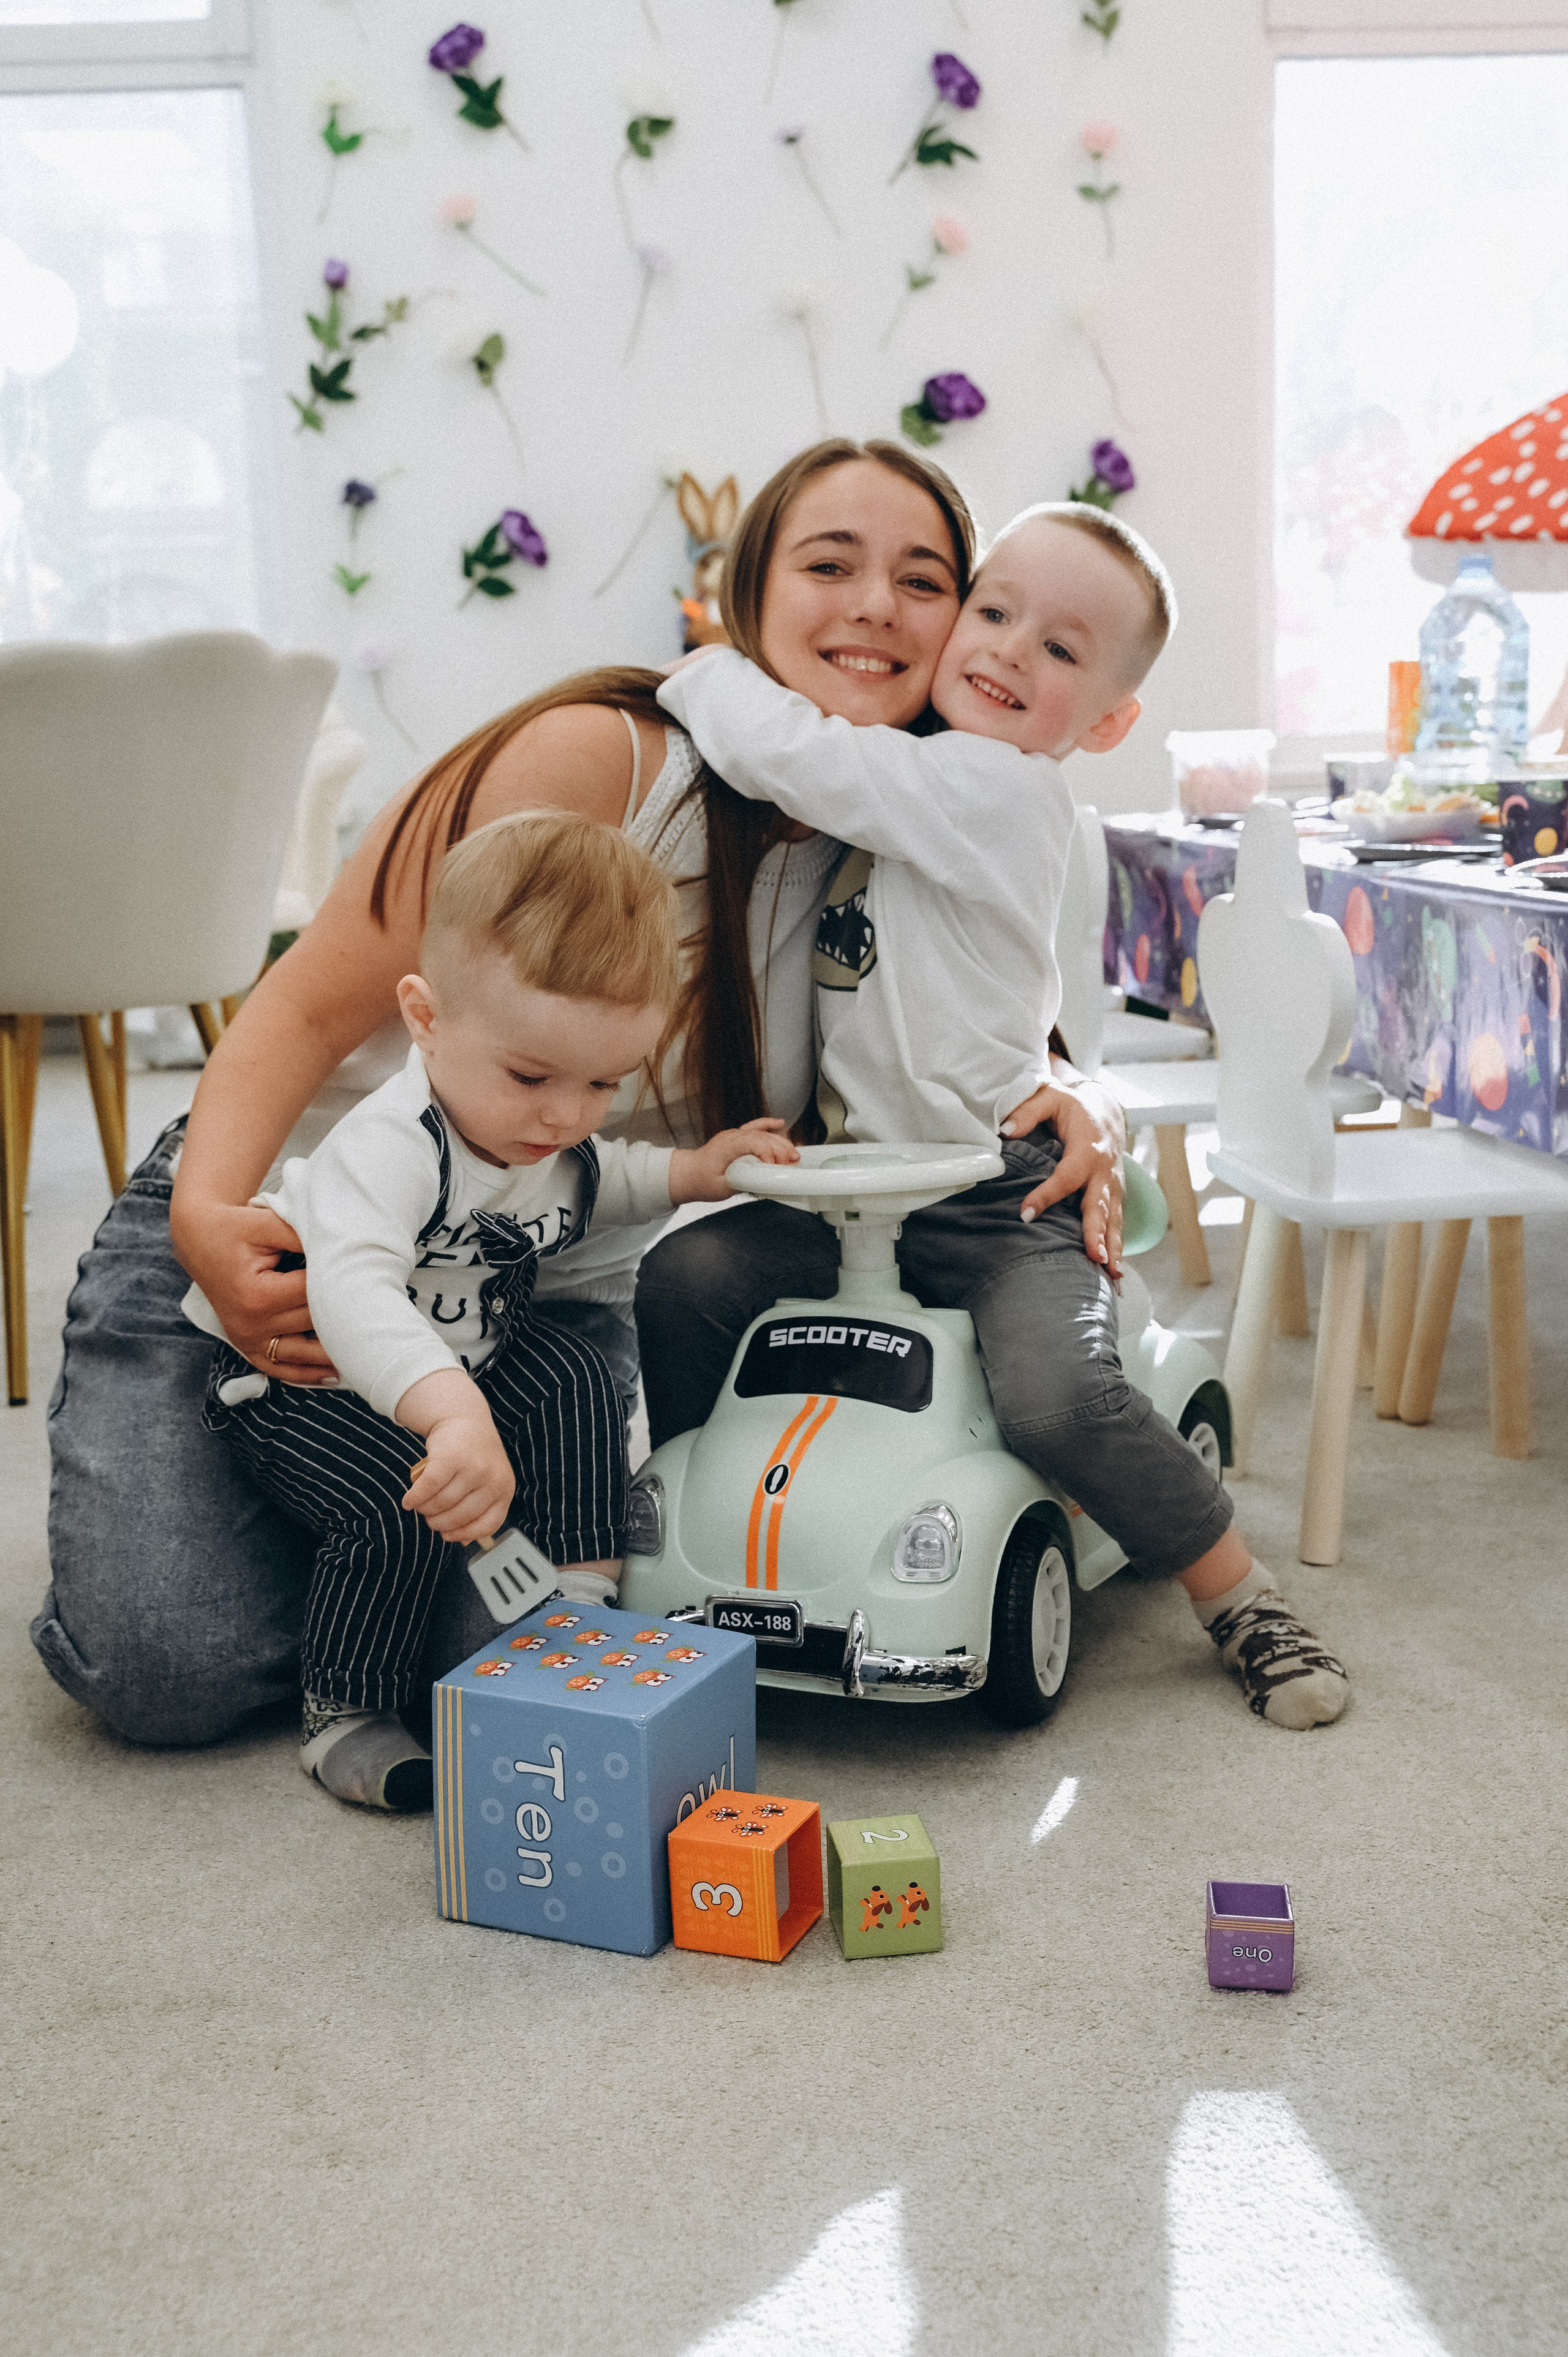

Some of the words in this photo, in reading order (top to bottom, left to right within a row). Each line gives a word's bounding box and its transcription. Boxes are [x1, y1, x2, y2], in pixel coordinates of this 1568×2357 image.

[769, 1326, 912, 1358] SCOOTER
[718, 1611, 791, 1631] ASX-188
[514, 1746, 566, 1888] Ten
[860, 1828, 909, 1844] 2
[691, 1881, 743, 1917] 3
[1232, 1945, 1273, 1963] One
